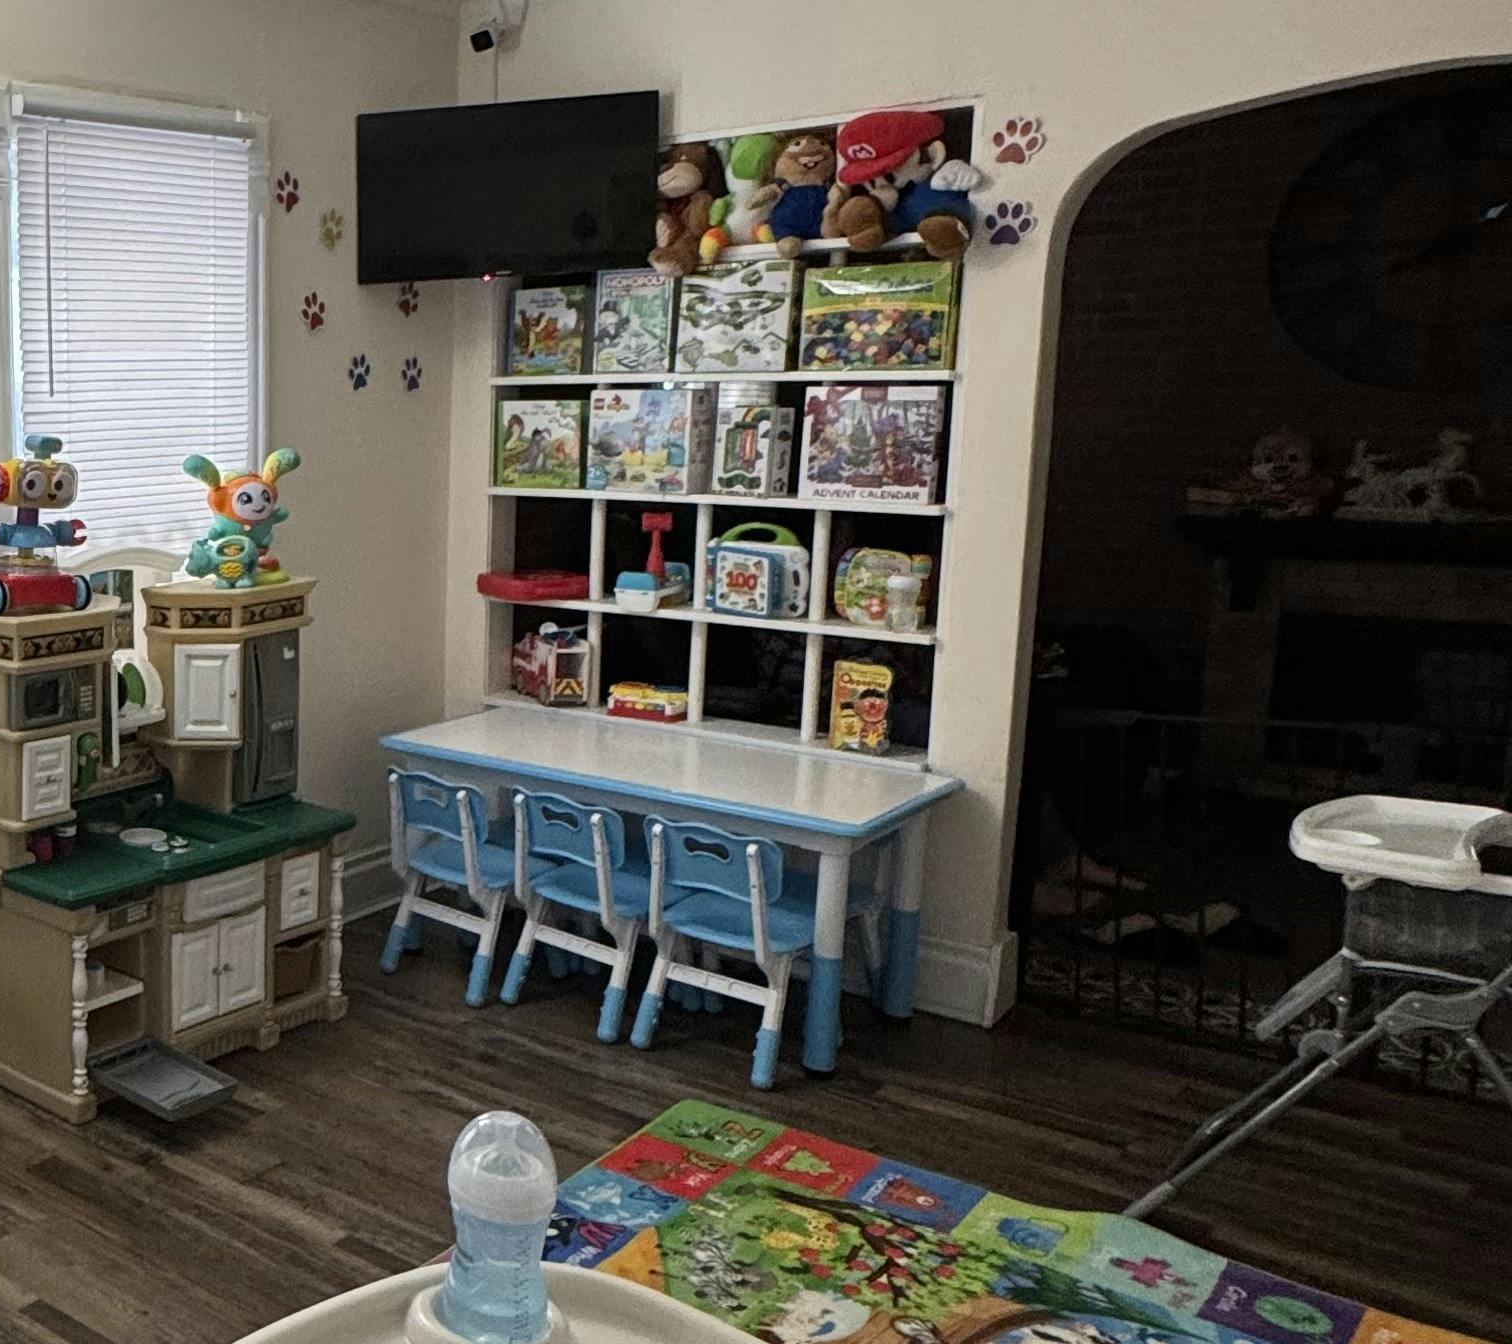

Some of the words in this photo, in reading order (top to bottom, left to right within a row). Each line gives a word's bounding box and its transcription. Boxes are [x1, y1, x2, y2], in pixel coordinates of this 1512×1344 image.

[605, 275, 666, 287] MONOPOLY
[812, 487, 856, 499] ADVENT
[859, 489, 920, 501] CALENDAR
[725, 570, 759, 590] 100
